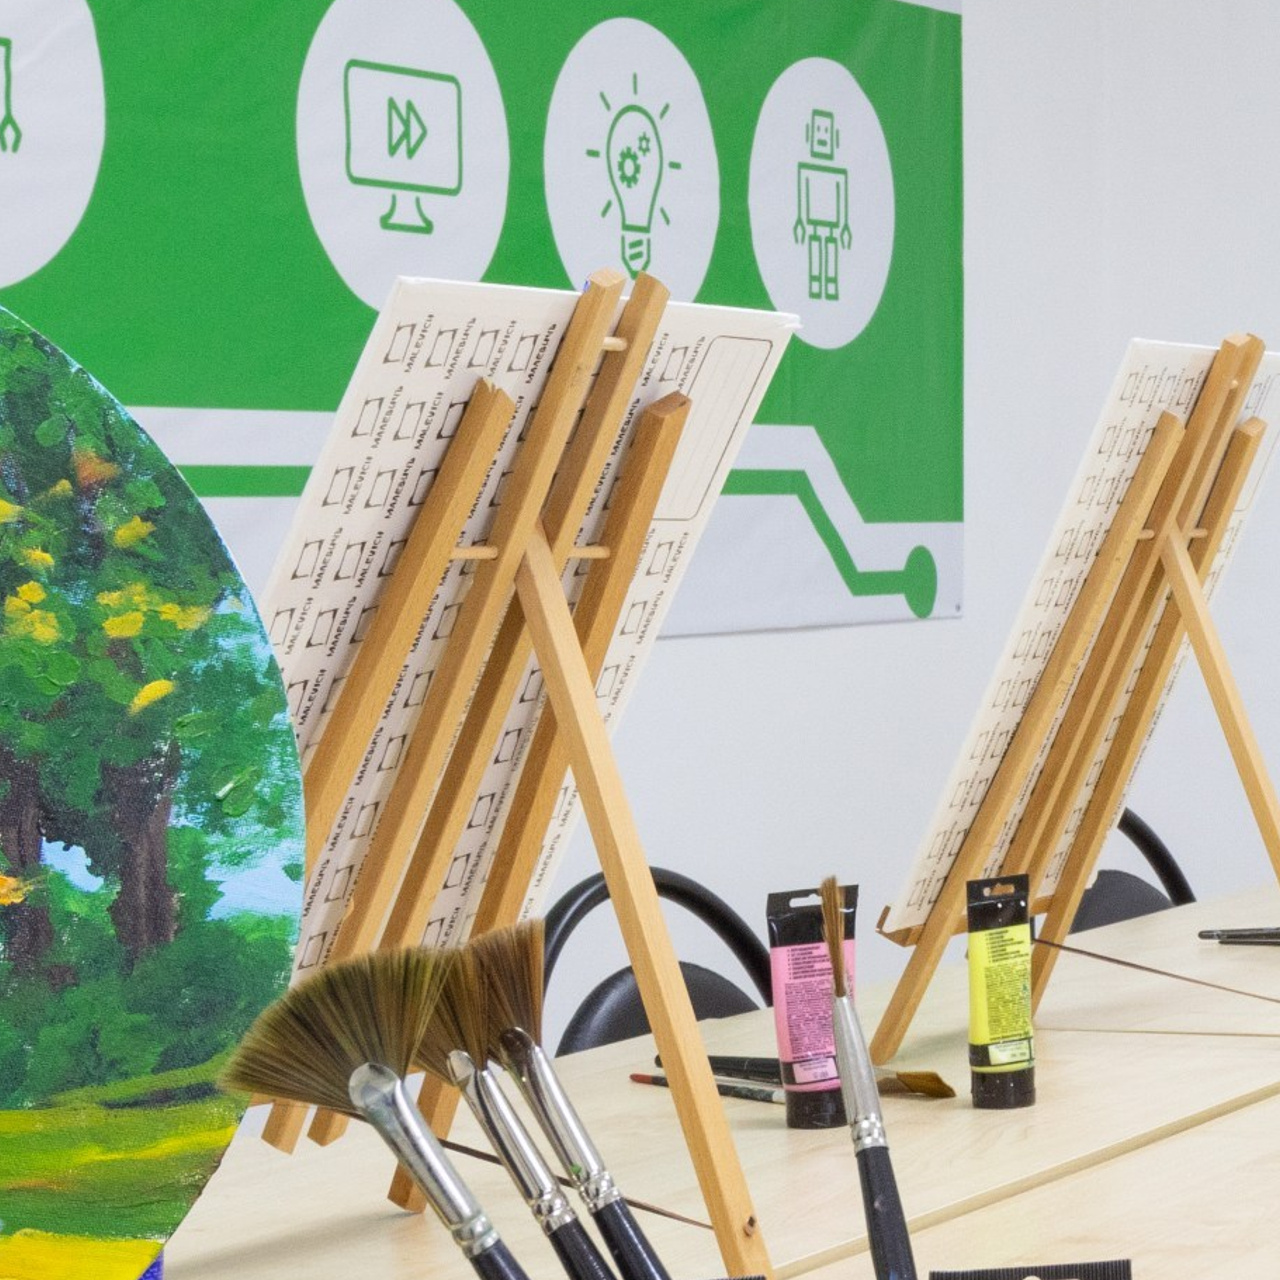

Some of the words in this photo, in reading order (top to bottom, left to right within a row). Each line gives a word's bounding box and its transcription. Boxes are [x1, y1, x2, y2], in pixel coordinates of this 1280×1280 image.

[404, 314, 434, 373] MALEVICH
[641, 332, 669, 387] MALEVICH
[414, 392, 444, 450] MALEVICH
[344, 456, 373, 515] MALEVICH
[356, 531, 384, 588] MALEVICH
[285, 597, 314, 656] MALEVICH
[299, 669, 327, 726] MALEVICH
[382, 664, 410, 720] MALEVICH
[328, 797, 355, 852] MALEVICH
